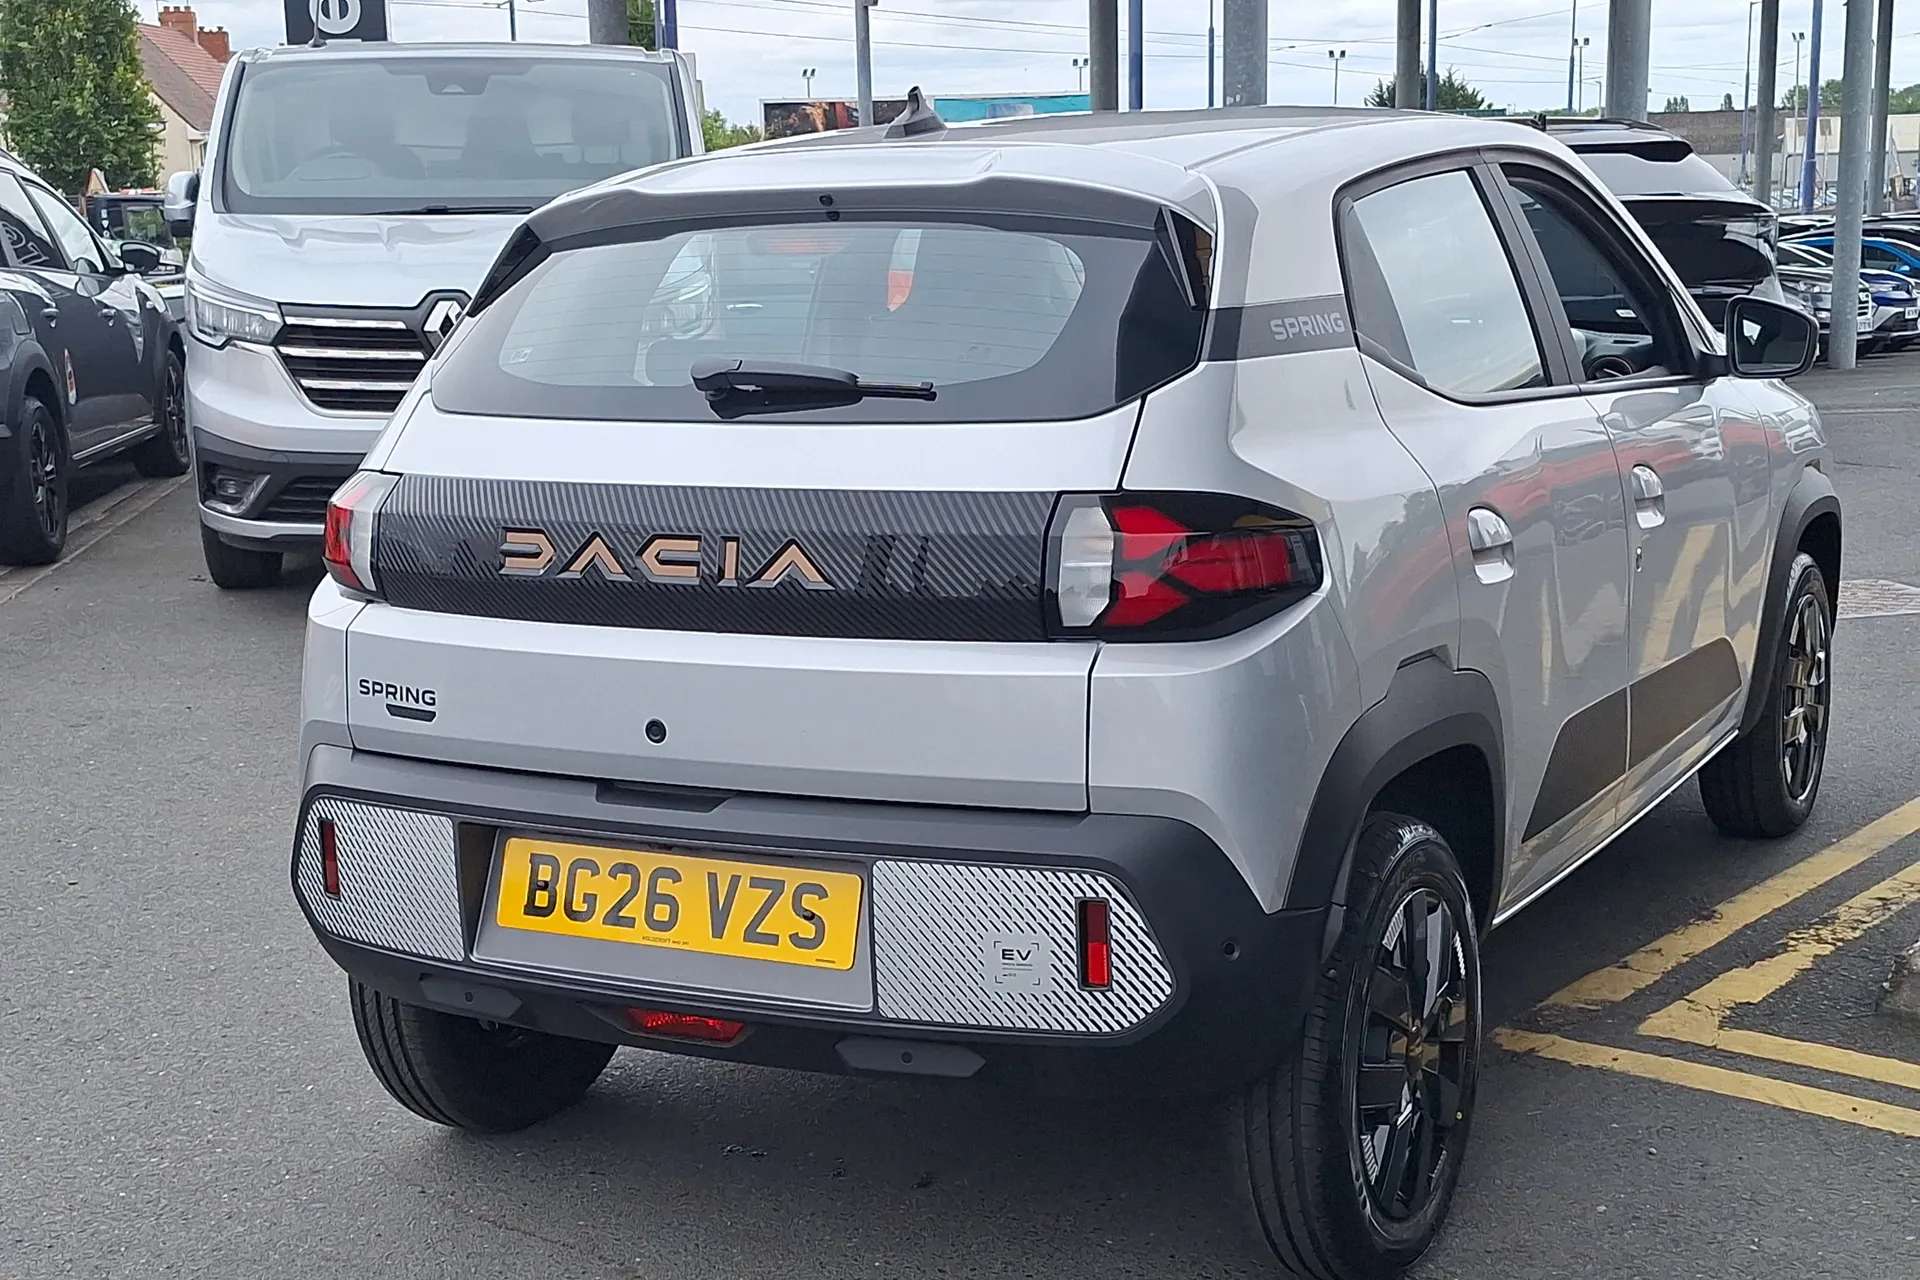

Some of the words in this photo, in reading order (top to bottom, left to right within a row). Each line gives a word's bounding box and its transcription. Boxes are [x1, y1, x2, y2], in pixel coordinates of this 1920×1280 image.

[1270, 312, 1345, 341] SPRING
[499, 527, 835, 590] DACIA
[359, 678, 436, 706] SPRING
[523, 853, 682, 933] BG26
[707, 872, 829, 950] VZS
[1001, 948, 1032, 961] EV
